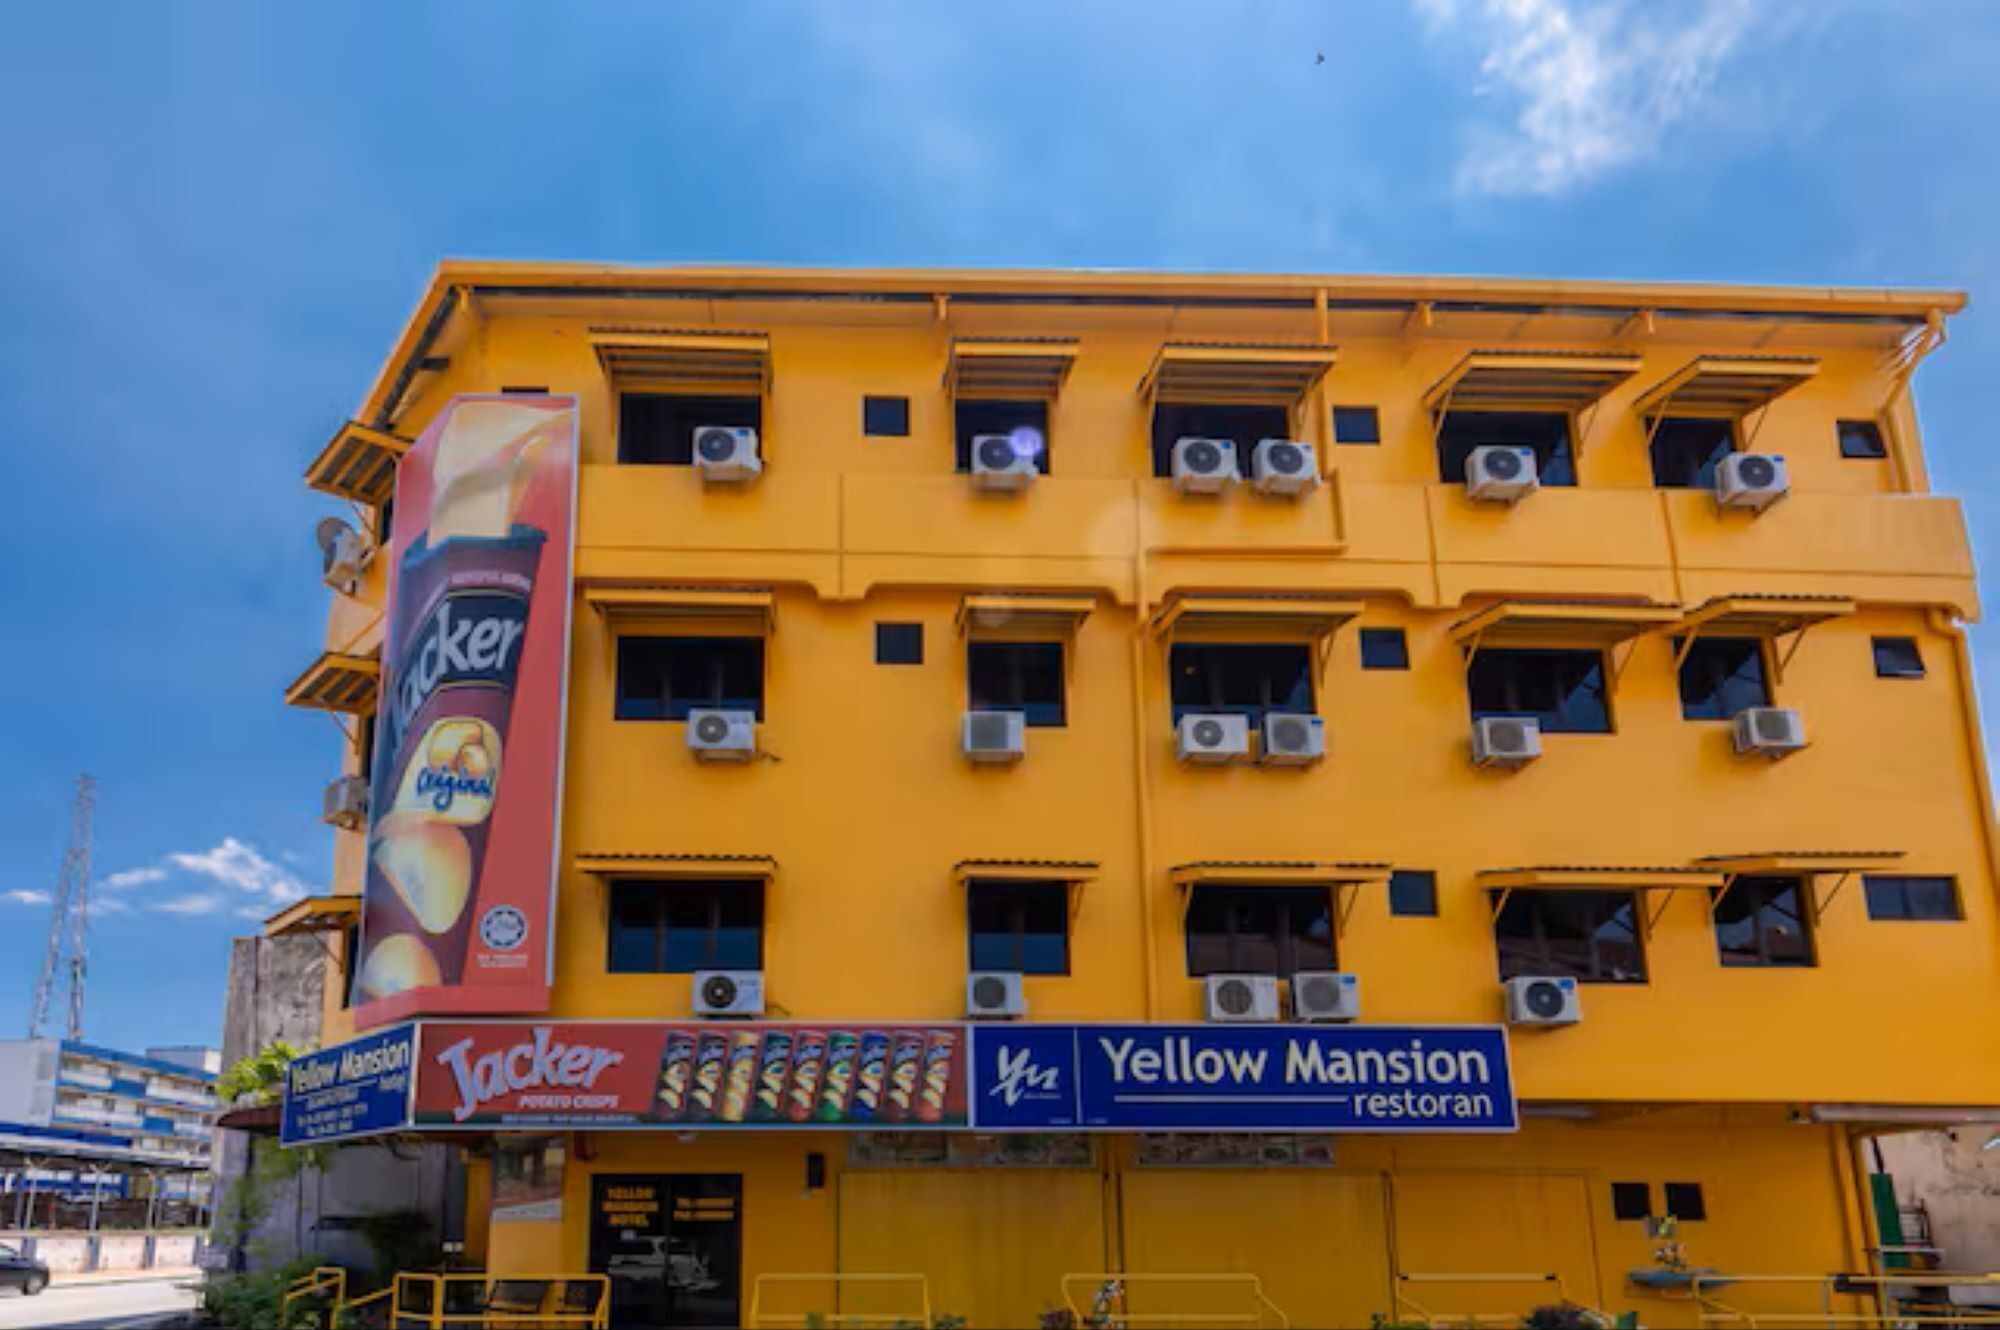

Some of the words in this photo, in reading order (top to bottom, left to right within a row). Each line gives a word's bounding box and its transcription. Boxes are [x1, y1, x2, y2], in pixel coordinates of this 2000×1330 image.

[436, 1026, 624, 1123] Jacker
[1098, 1036, 1268, 1084] Yellow
[1284, 1039, 1490, 1085] Mansion
[1353, 1089, 1493, 1118] restoran
